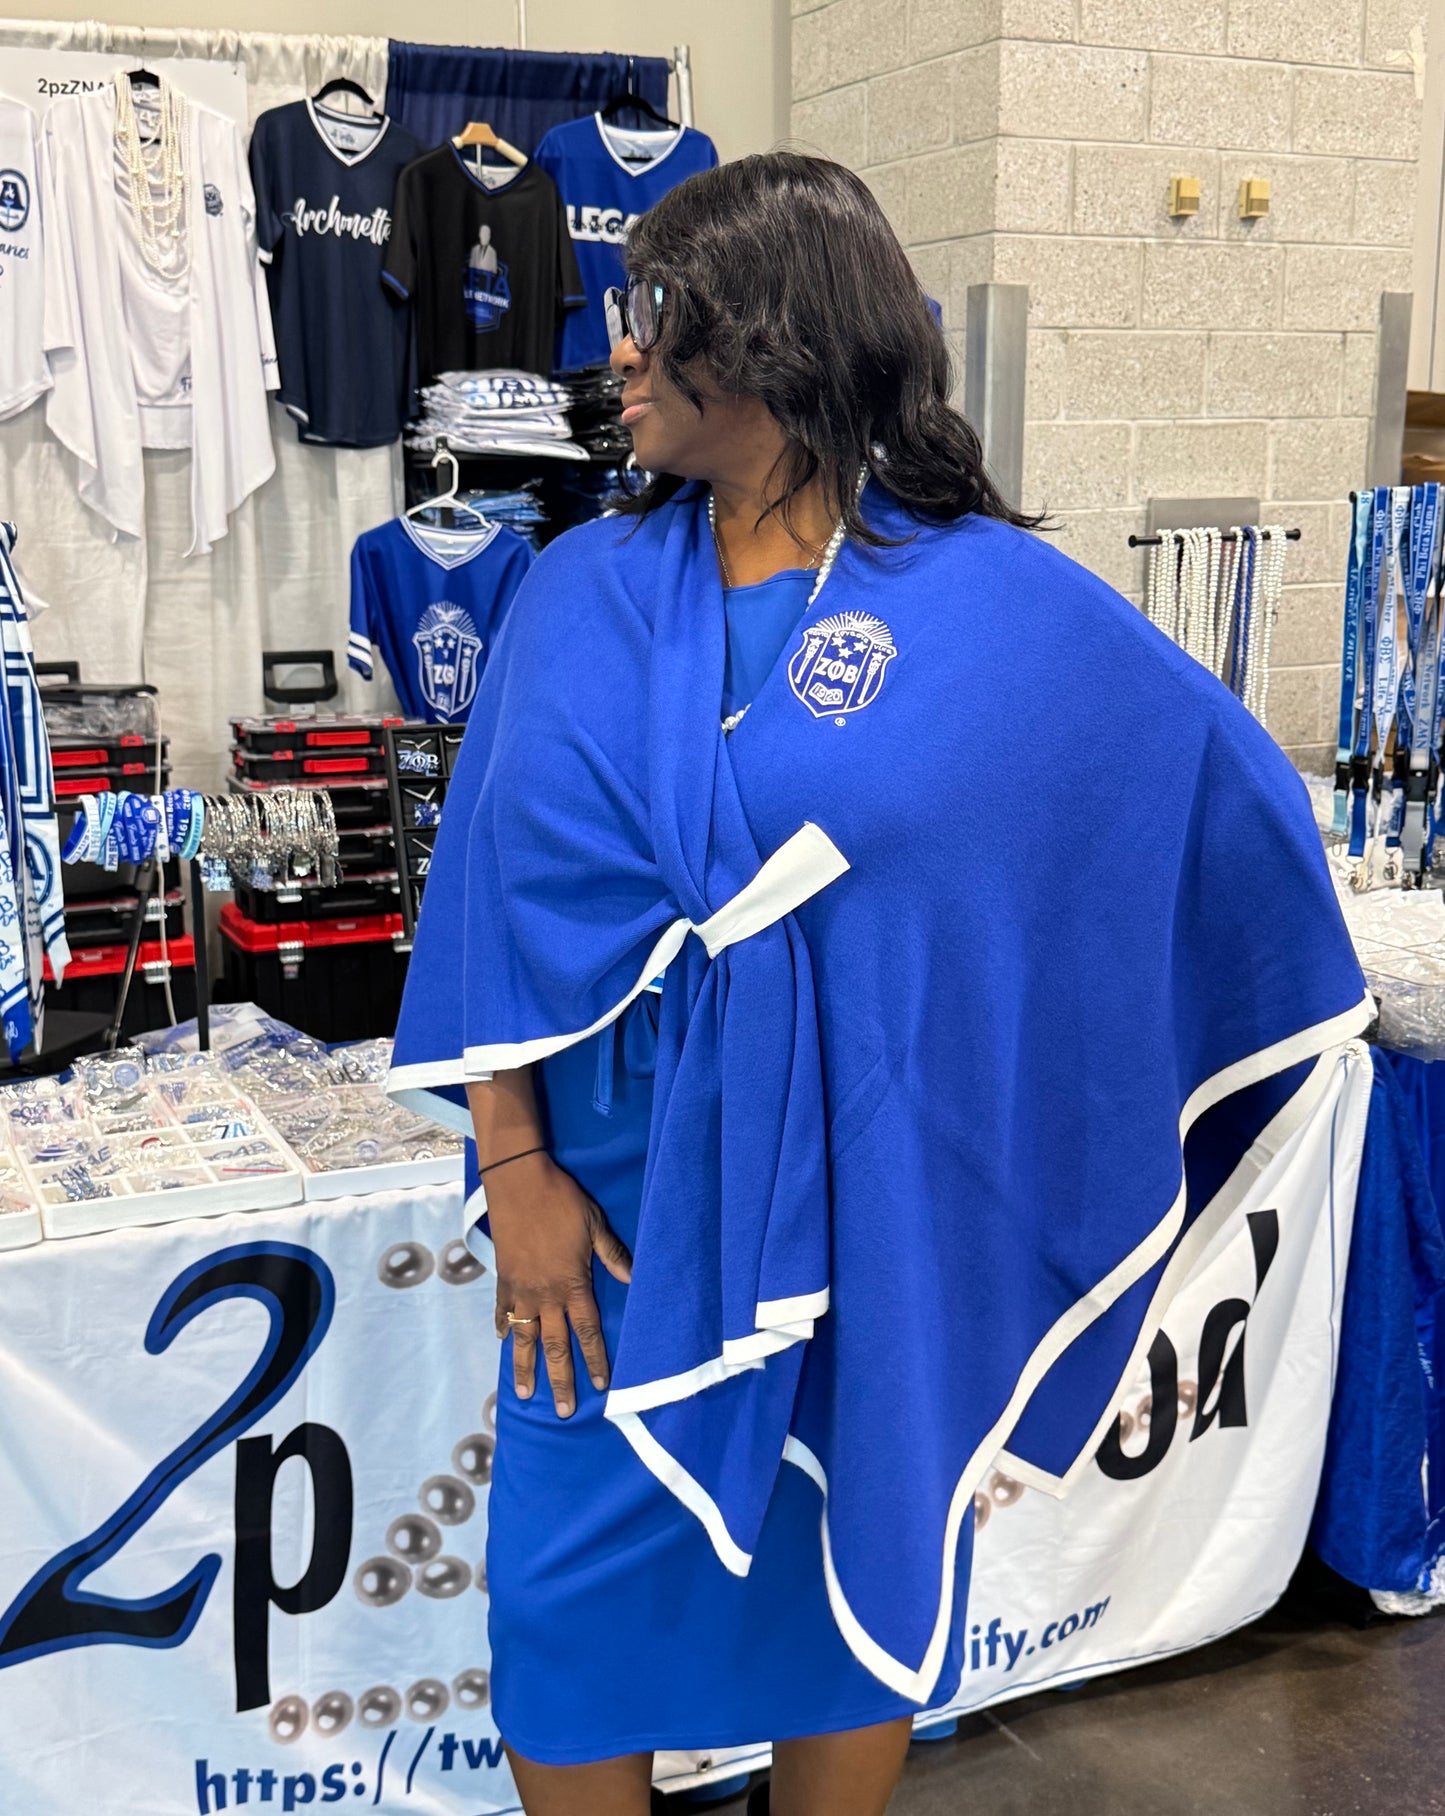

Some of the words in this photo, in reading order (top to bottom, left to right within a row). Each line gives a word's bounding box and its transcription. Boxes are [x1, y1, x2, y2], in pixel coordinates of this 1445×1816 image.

[1422, 505, 1435, 536] Sigma
[1419, 537, 1431, 560] Beta
[1417, 561, 1427, 579] Phi
[1380, 635, 1393, 664] ΦΒΣ
[1420, 663, 1436, 709] Network
[1415, 718, 1429, 750] ZMN
[174, 817, 190, 843] 1914
[970, 1595, 1112, 1673] ify.com
